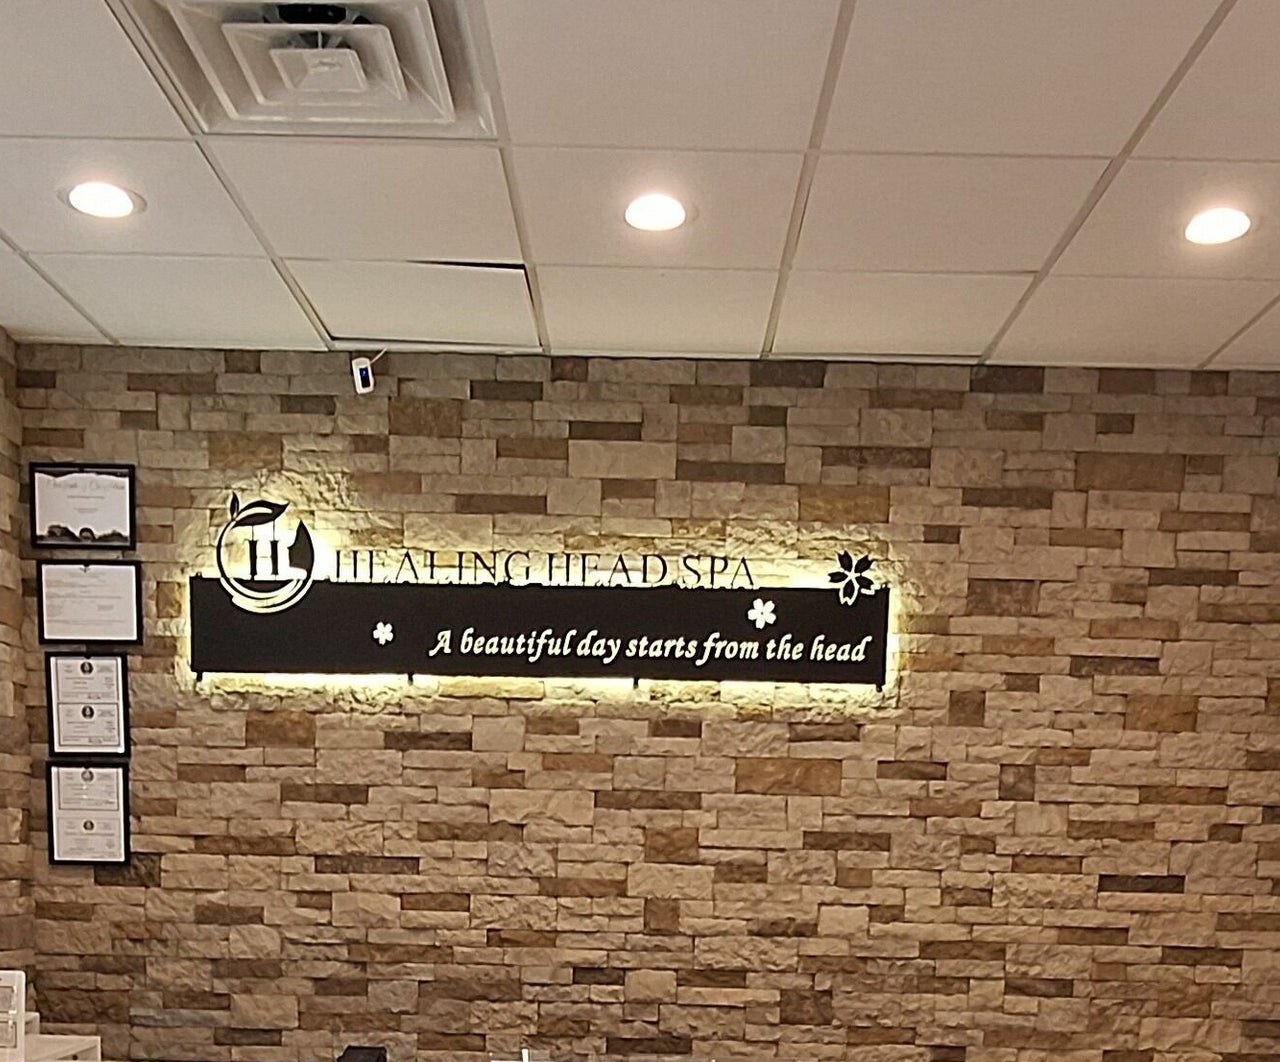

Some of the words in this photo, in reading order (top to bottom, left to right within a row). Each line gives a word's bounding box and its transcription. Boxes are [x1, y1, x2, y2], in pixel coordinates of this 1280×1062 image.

[334, 549, 533, 584] HEALING
[546, 551, 668, 586] HEAD
[682, 554, 757, 588] SPA
[428, 629, 454, 657] A
[459, 627, 577, 663] beautiful
[577, 629, 621, 664] day
[625, 635, 697, 659] starts
[694, 632, 760, 667] from
[765, 634, 803, 661] the
[809, 634, 872, 662] head
